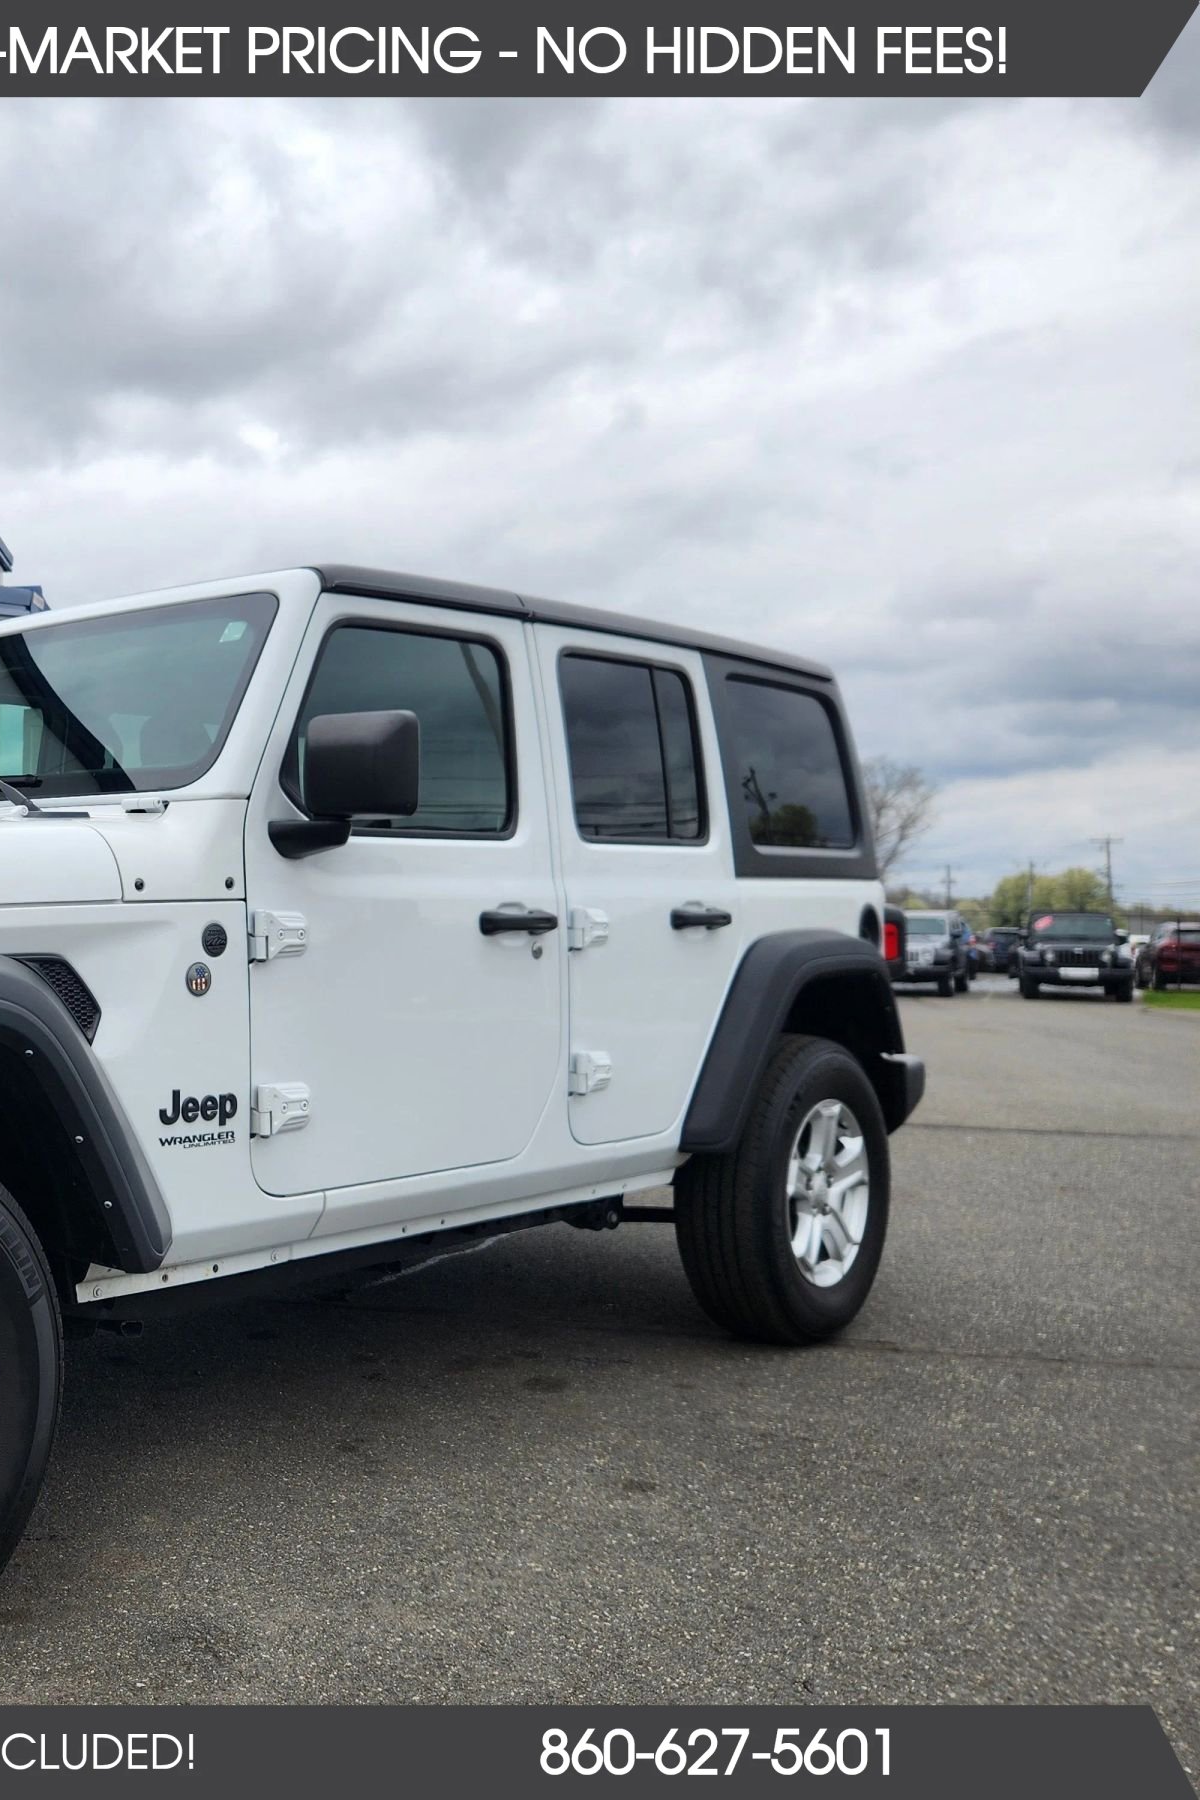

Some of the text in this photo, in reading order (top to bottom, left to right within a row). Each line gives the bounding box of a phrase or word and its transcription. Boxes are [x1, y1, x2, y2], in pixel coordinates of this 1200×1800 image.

[159, 1089, 237, 1126] Jeep
[159, 1131, 235, 1147] WRANGLER
[183, 1138, 236, 1149] UNLIMITED
